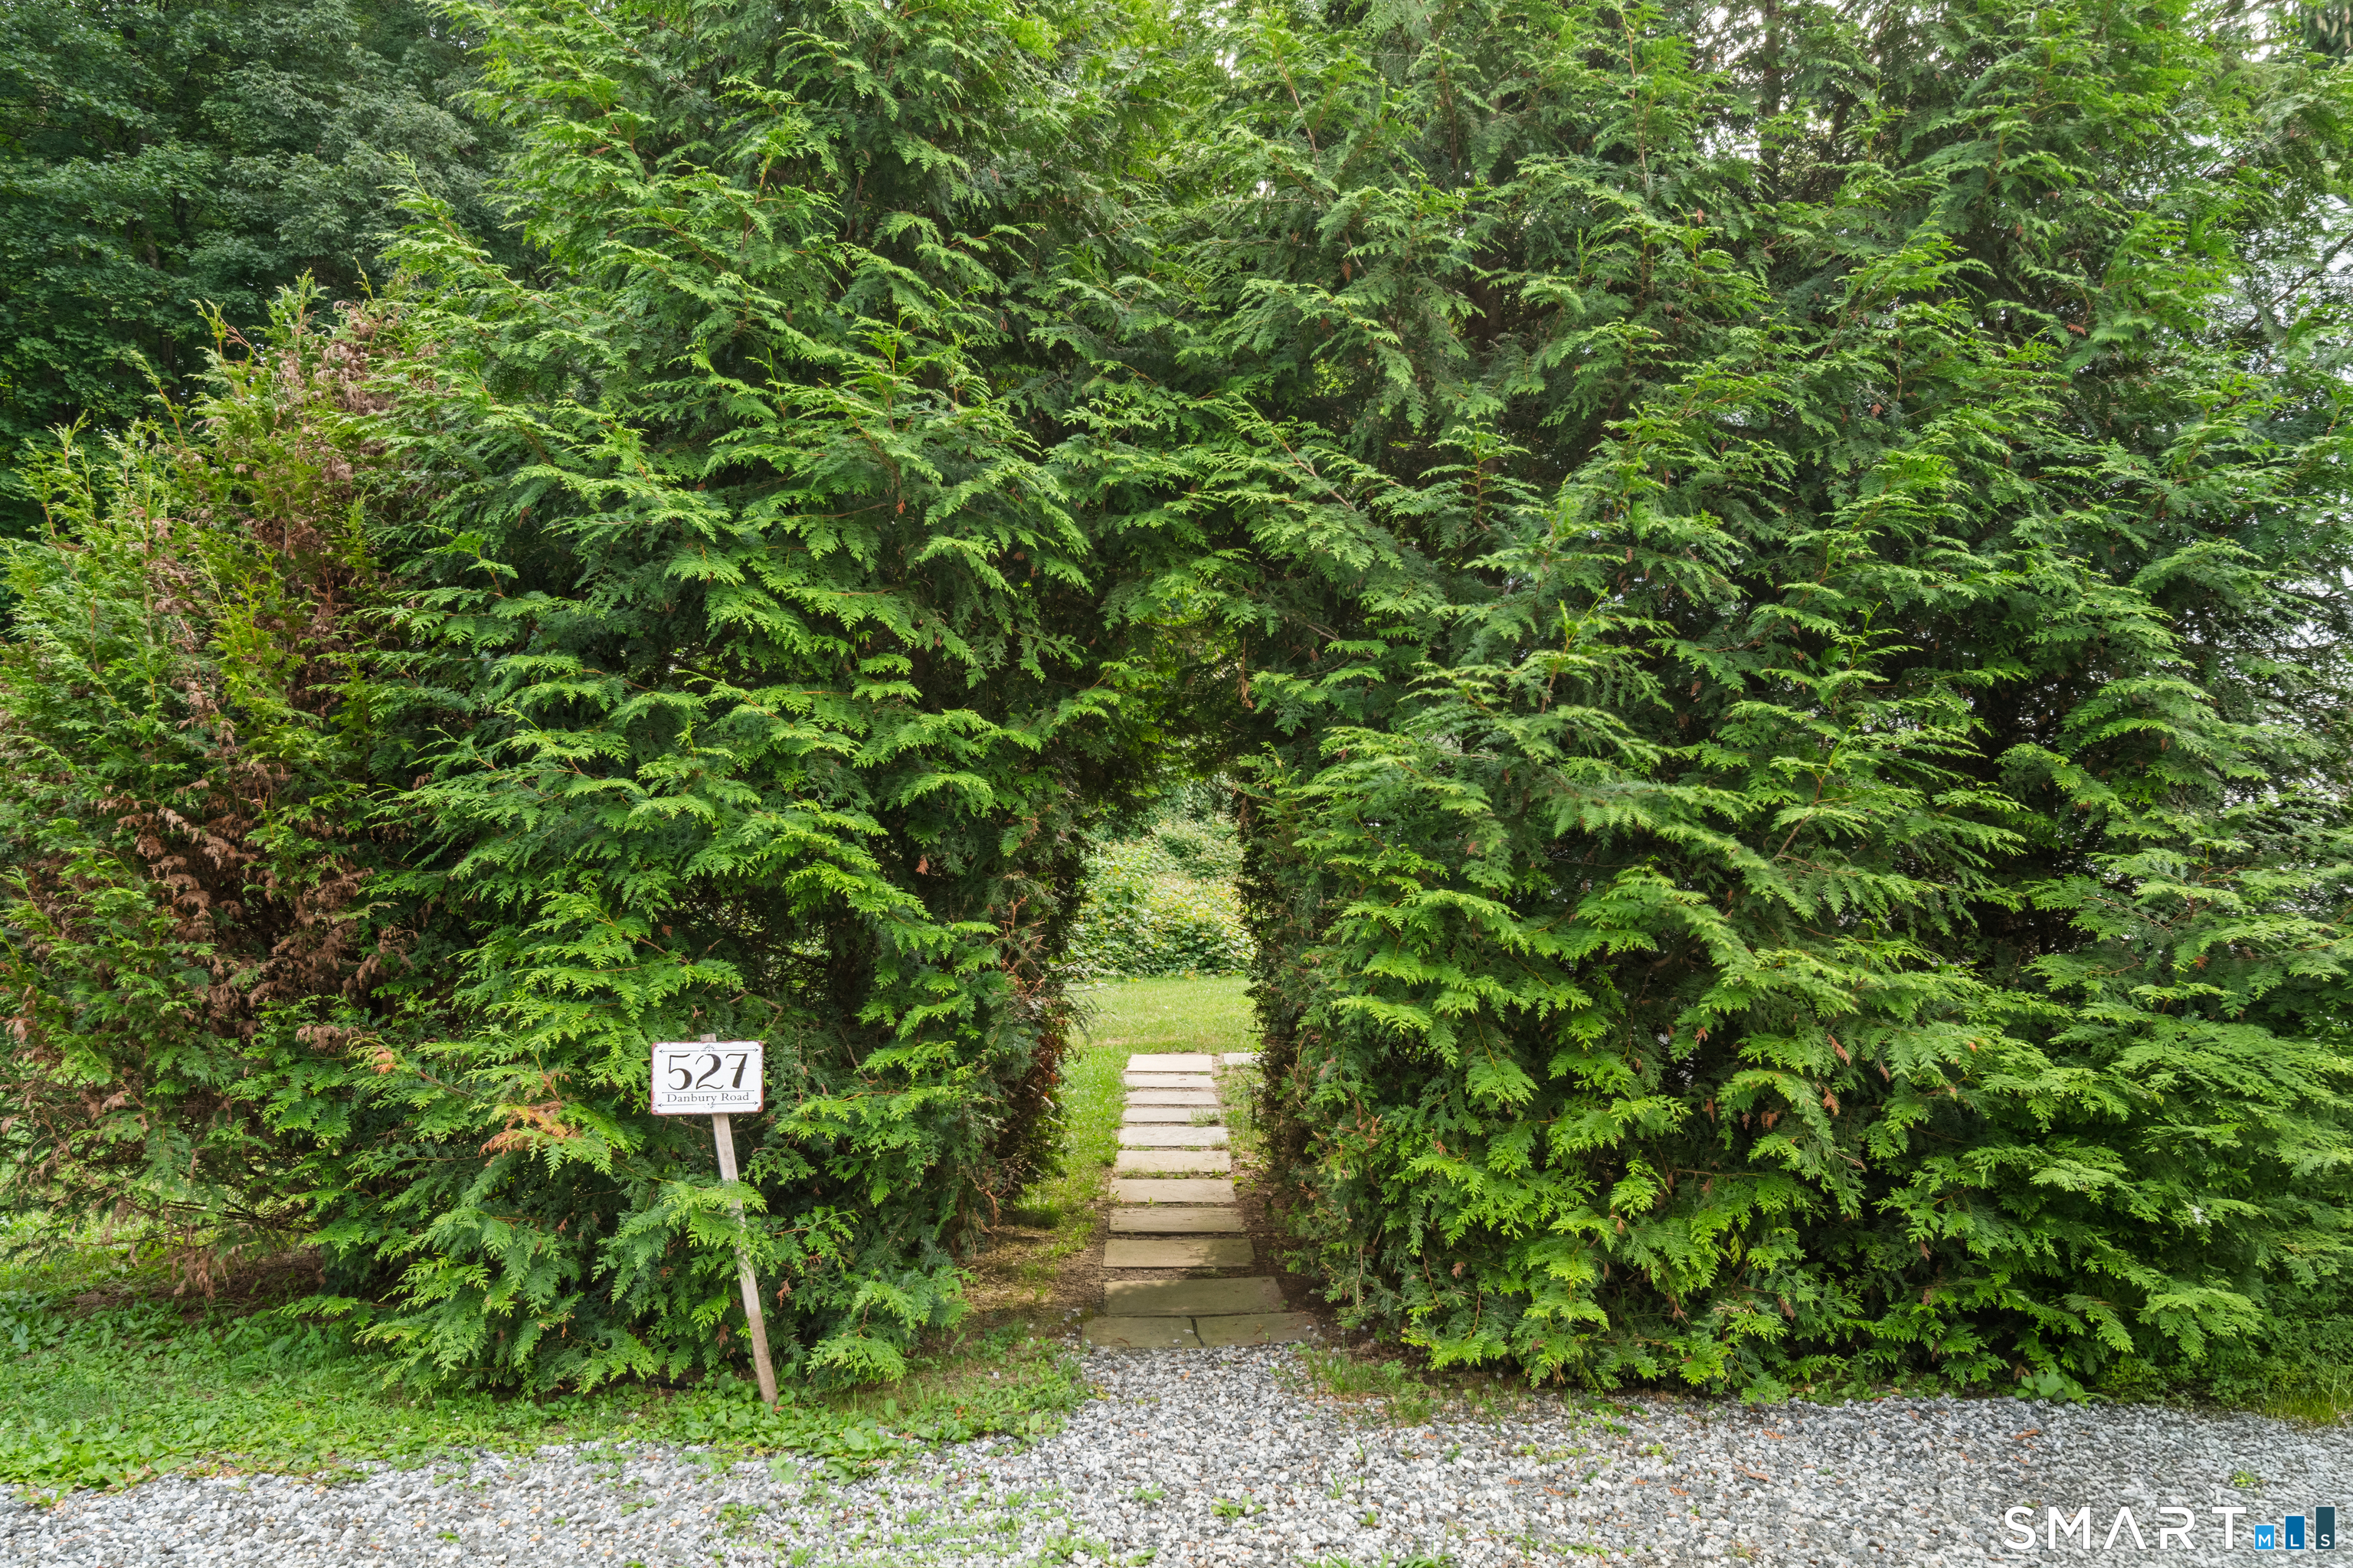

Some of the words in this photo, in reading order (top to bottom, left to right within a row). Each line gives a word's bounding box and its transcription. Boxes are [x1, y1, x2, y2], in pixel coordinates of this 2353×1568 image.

[668, 1053, 748, 1091] 527
[667, 1094, 717, 1104] Danbury
[721, 1092, 749, 1102] Road
